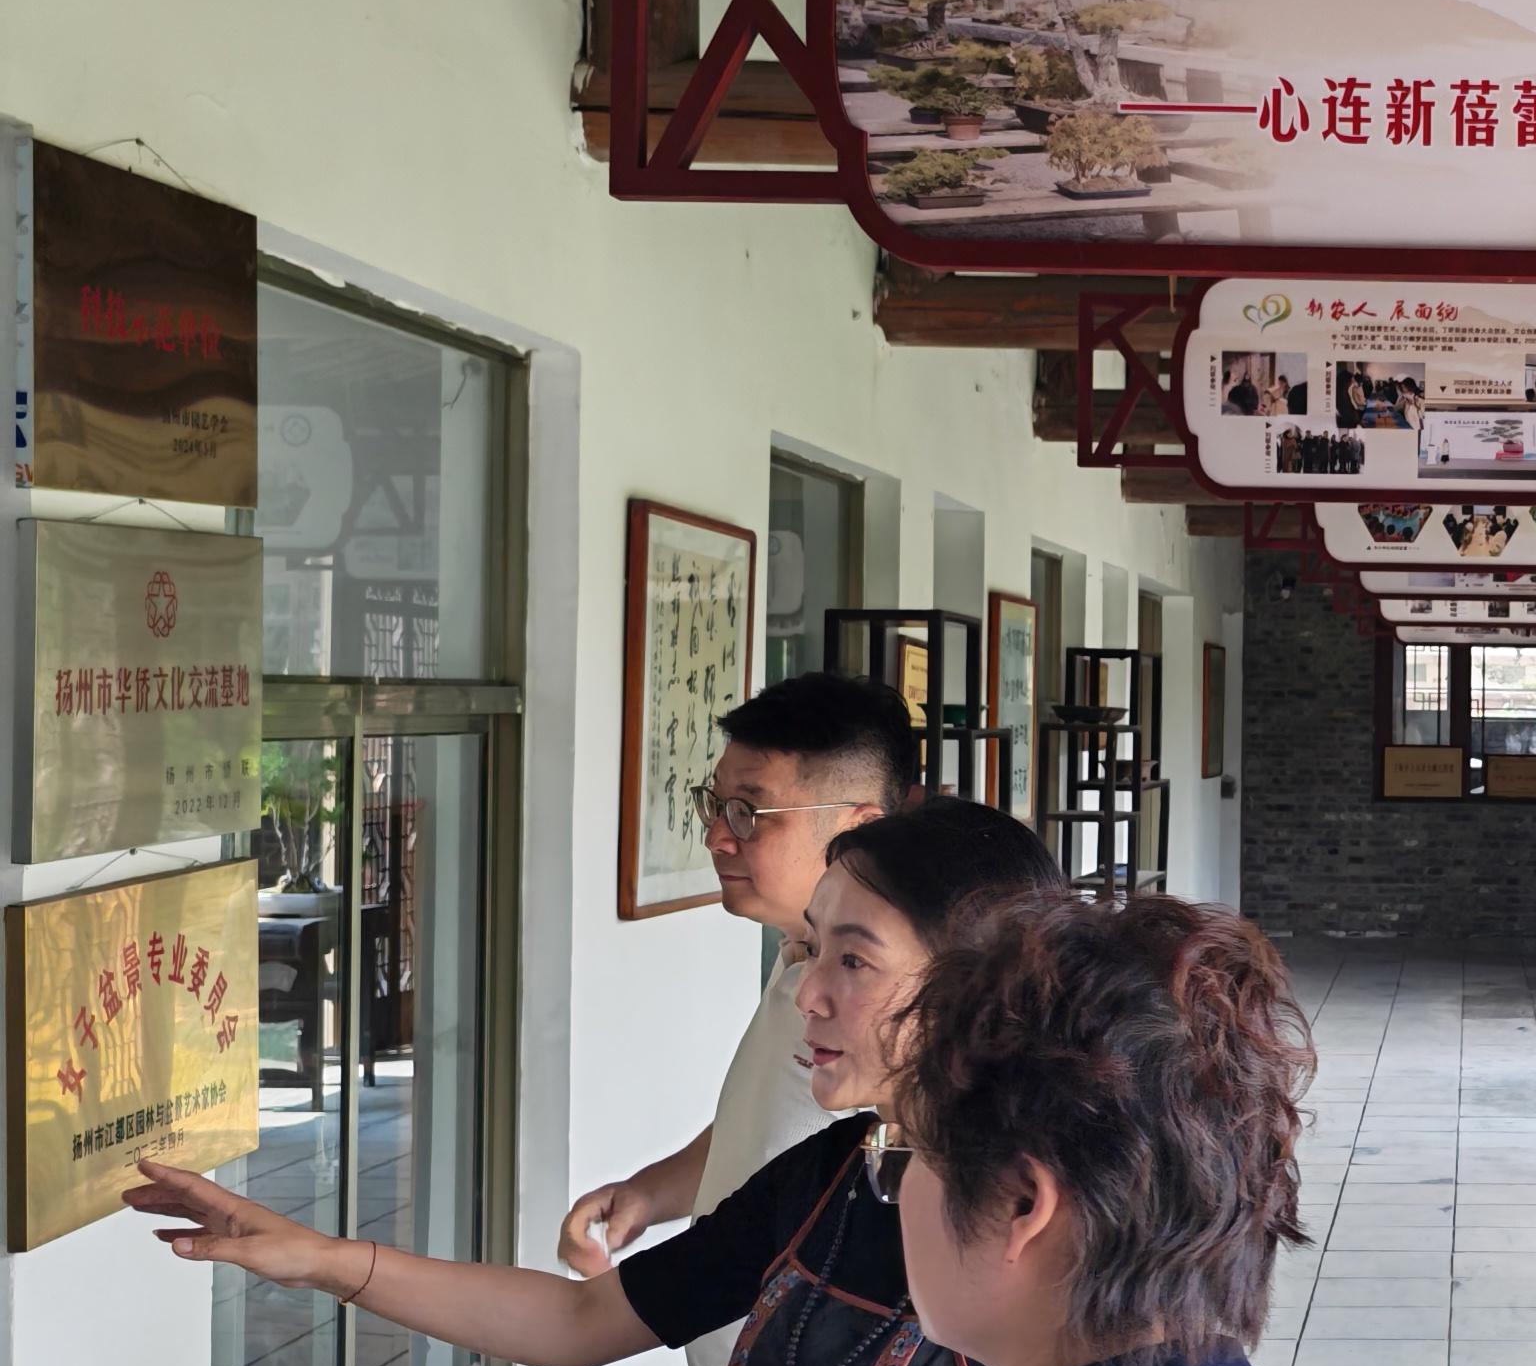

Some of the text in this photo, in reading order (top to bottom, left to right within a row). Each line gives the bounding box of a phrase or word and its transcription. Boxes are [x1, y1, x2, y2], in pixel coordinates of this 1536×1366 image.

[1304, 298, 1378, 321] 新农人
[55, 665, 250, 716] 扬州市华侨文化交流基地
[57, 931, 239, 1103] 女子盆景专业委员会
